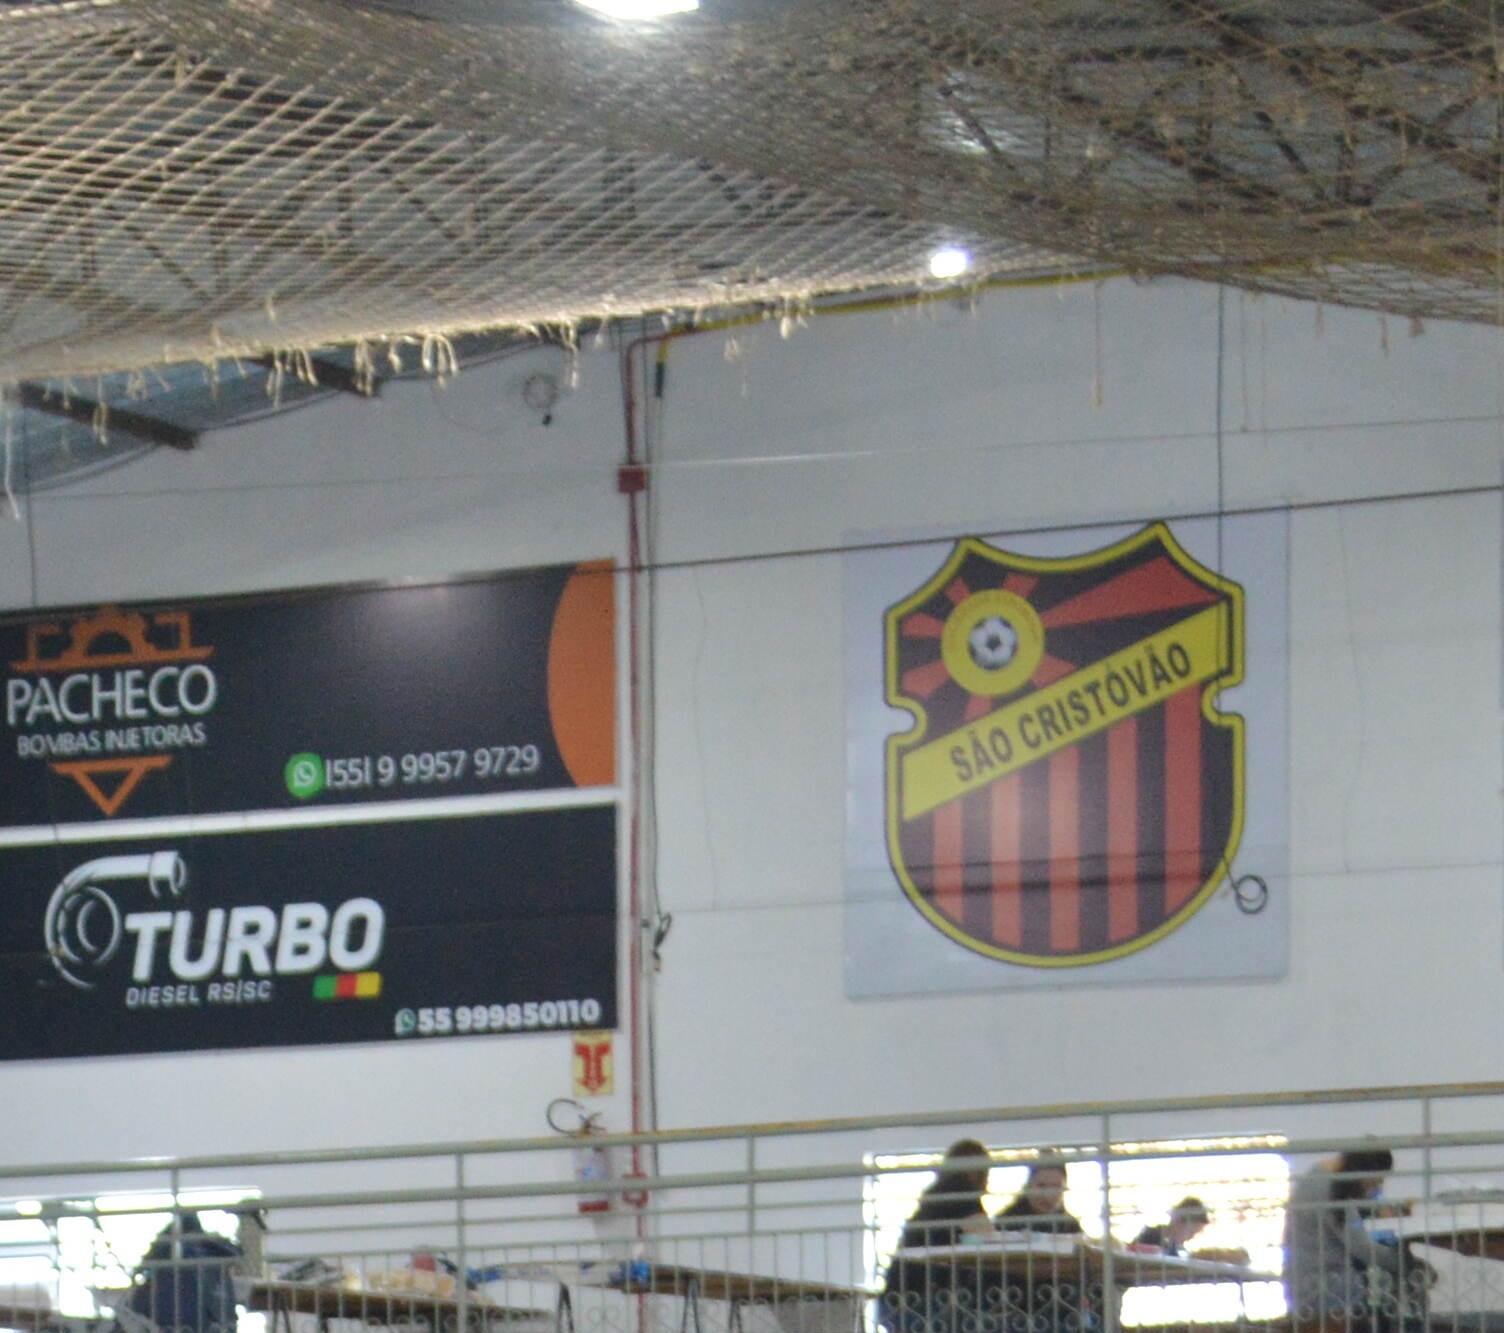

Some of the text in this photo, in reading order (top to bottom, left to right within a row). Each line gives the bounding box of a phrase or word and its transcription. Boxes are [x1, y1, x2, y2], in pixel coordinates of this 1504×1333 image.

[6, 663, 219, 727] PACHECO
[950, 636, 1192, 783] SÃO CRISTÓVÃO
[17, 722, 207, 757] BOMBAS INJETORAS
[378, 755, 395, 785] 9
[401, 749, 467, 783] 9957
[473, 744, 539, 777] 9729
[124, 897, 386, 983] TURBO
[124, 984, 200, 1007] DIESEL
[417, 998, 601, 1033] 55 999850110
